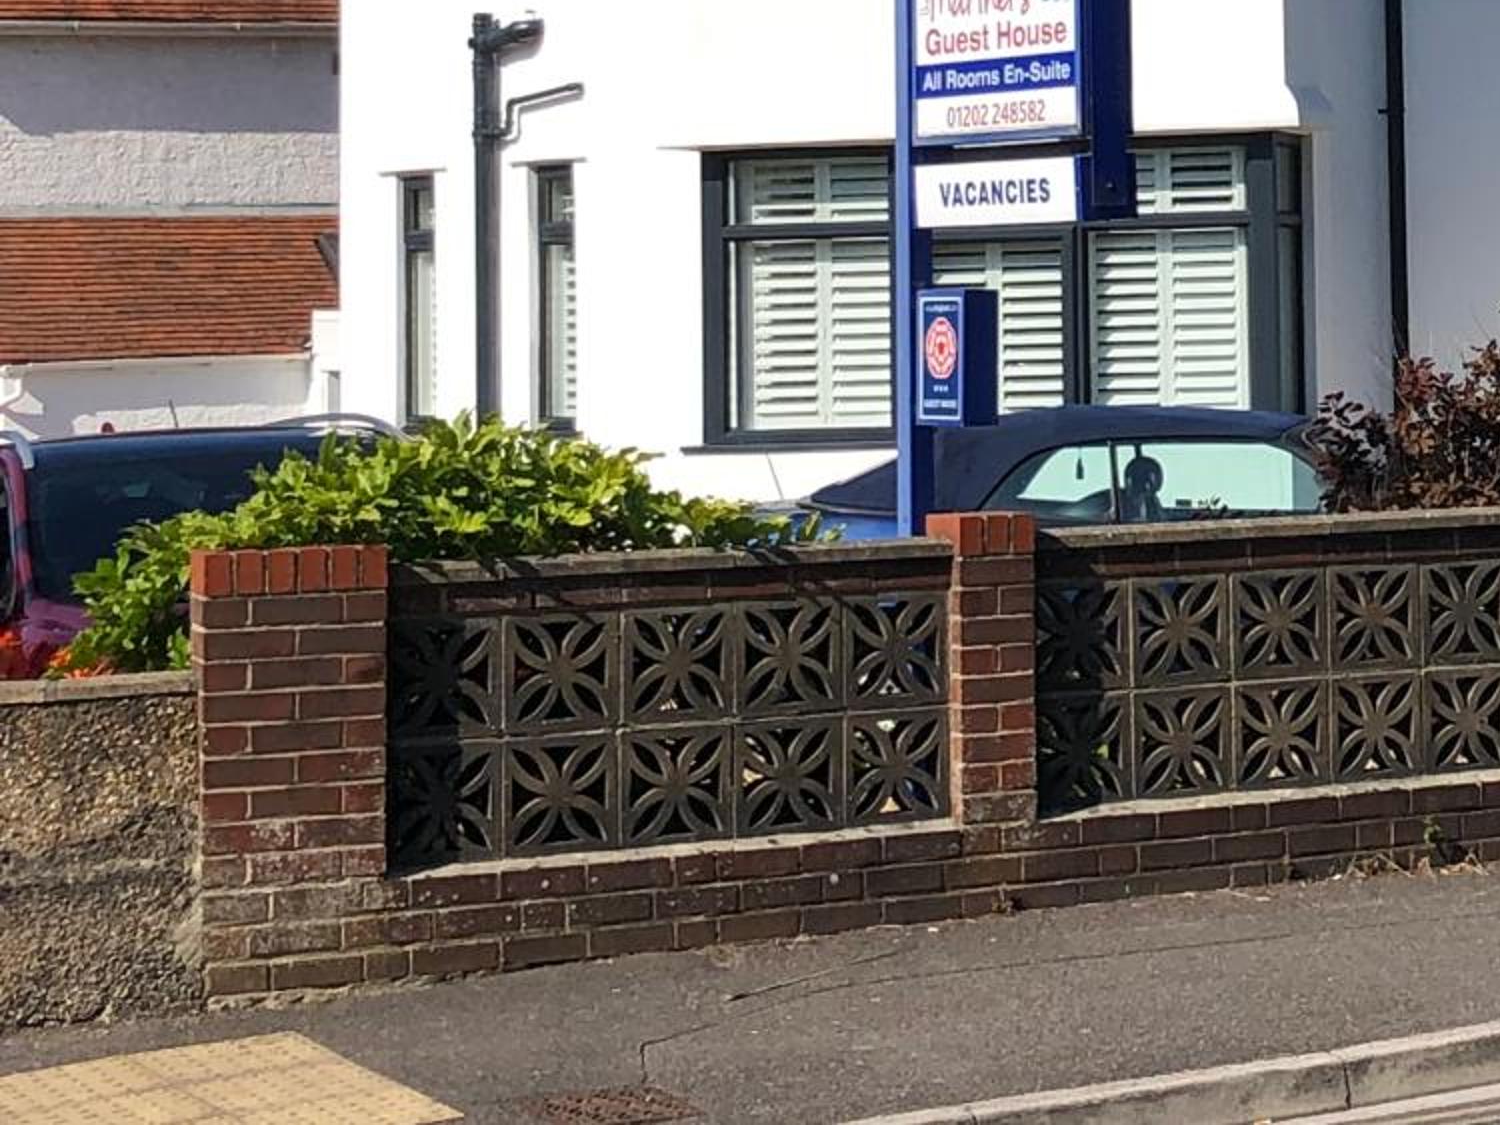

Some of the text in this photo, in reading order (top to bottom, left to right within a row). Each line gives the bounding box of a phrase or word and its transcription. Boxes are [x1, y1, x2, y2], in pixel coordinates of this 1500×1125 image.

[925, 19, 1068, 56] Guest House
[922, 60, 1071, 92] All Rooms En-Suite
[946, 99, 1046, 128] 01202 248582
[938, 177, 1051, 208] VACANCIES
